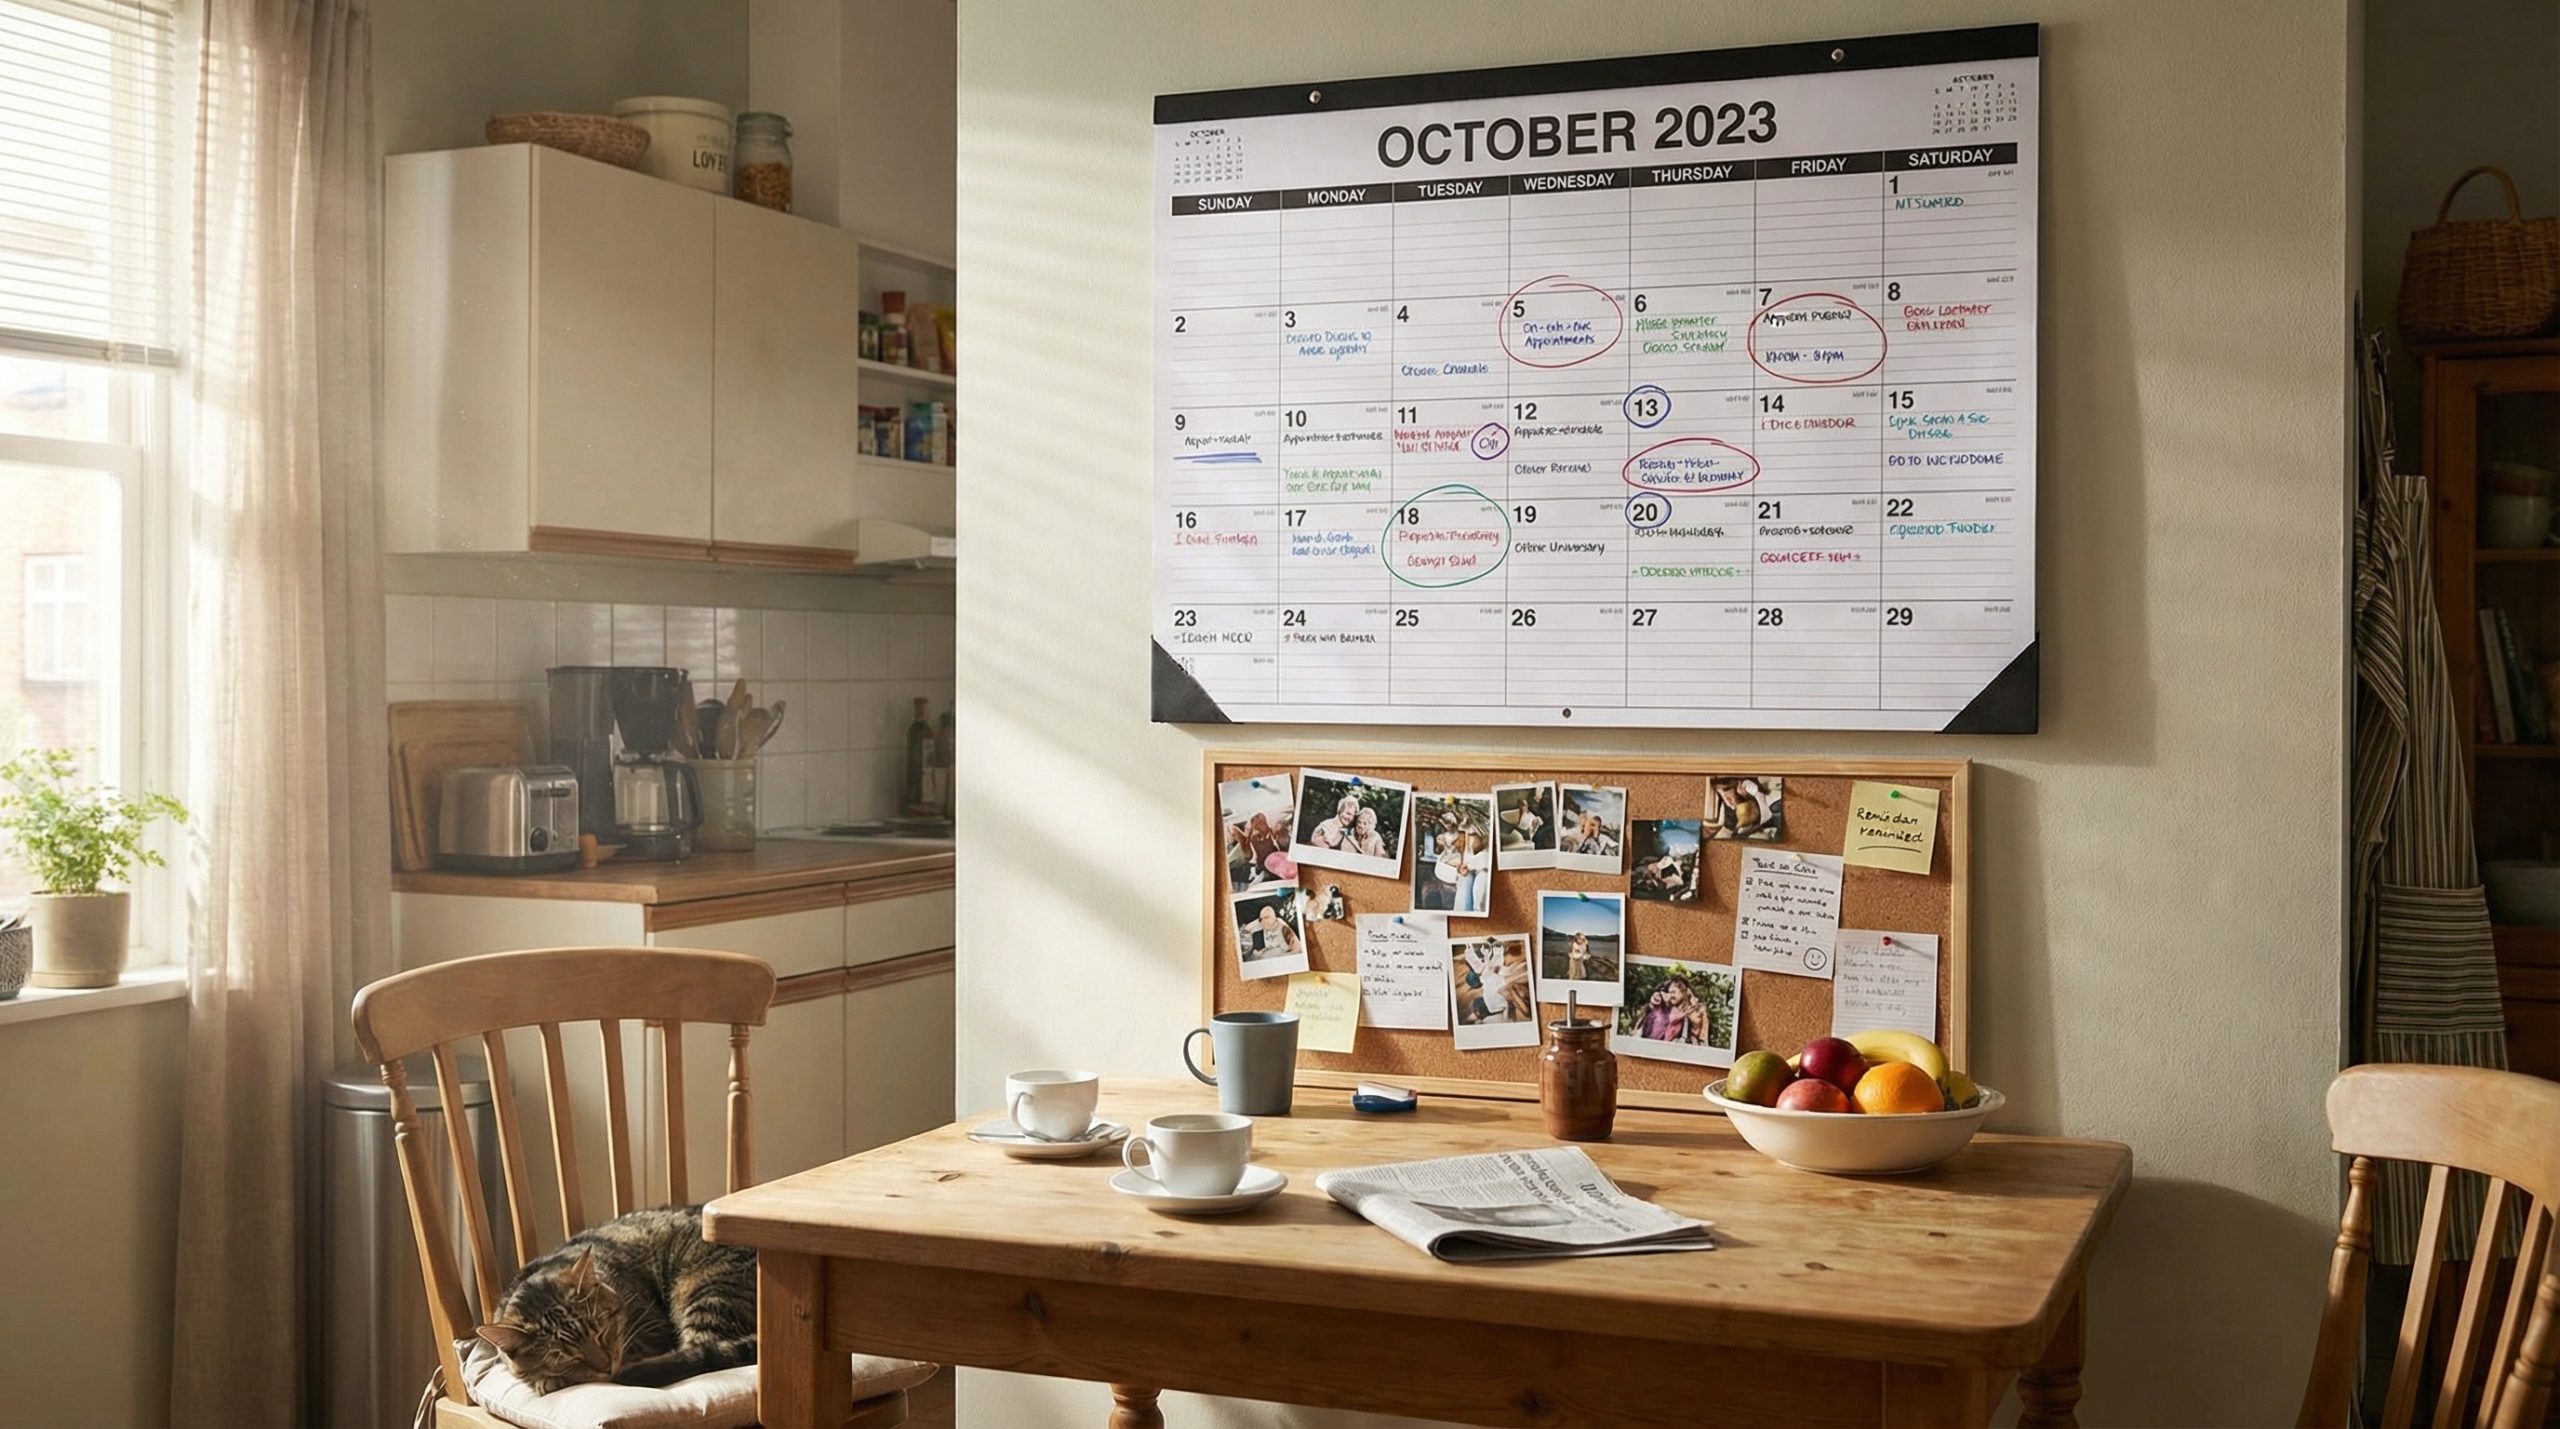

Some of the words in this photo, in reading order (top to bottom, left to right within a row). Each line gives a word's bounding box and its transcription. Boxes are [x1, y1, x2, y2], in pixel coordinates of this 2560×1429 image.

[1378, 111, 1635, 167] OCTOBER
[1654, 101, 1777, 149] 2023
[1791, 157, 1848, 175] FRIDAY
[1908, 148, 1993, 167] SATURDAY
[1523, 173, 1615, 191] WEDNESDAY
[1652, 164, 1733, 183] THURSDAY
[1418, 181, 1484, 198] TUESDAY
[1889, 175, 1898, 194] 1
[1198, 195, 1253, 211] SUNDAY
[1307, 188, 1367, 205] MONDAY
[1759, 288, 1772, 306] 7
[1888, 282, 1900, 301] 8
[1514, 301, 1524, 317] 5
[1635, 295, 1646, 312] 6
[1286, 311, 1295, 327] 3
[1397, 306, 1408, 322] 4
[1176, 317, 1185, 332] 2
[1635, 399, 1658, 416] 13
[1760, 395, 1784, 412] 14
[1889, 391, 1913, 409] 15
[1286, 411, 1306, 426] 10
[1398, 407, 1415, 423] 11
[1515, 403, 1536, 419] 12
[1176, 415, 1185, 430] 9
[1398, 507, 1420, 525] 18
[1514, 506, 1536, 523] 19
[1633, 504, 1657, 522] 20
[1759, 502, 1780, 519] 21
[1887, 499, 1913, 516] 22
[1177, 512, 1196, 528] 16
[1286, 510, 1306, 526] 17
[1175, 610, 1196, 626] 23
[1284, 610, 1305, 626] 24
[1396, 610, 1418, 626] 25
[1512, 609, 1535, 626] 26
[1633, 609, 1657, 626] 27
[1758, 608, 1783, 626] 28
[1887, 608, 1912, 626] 29
